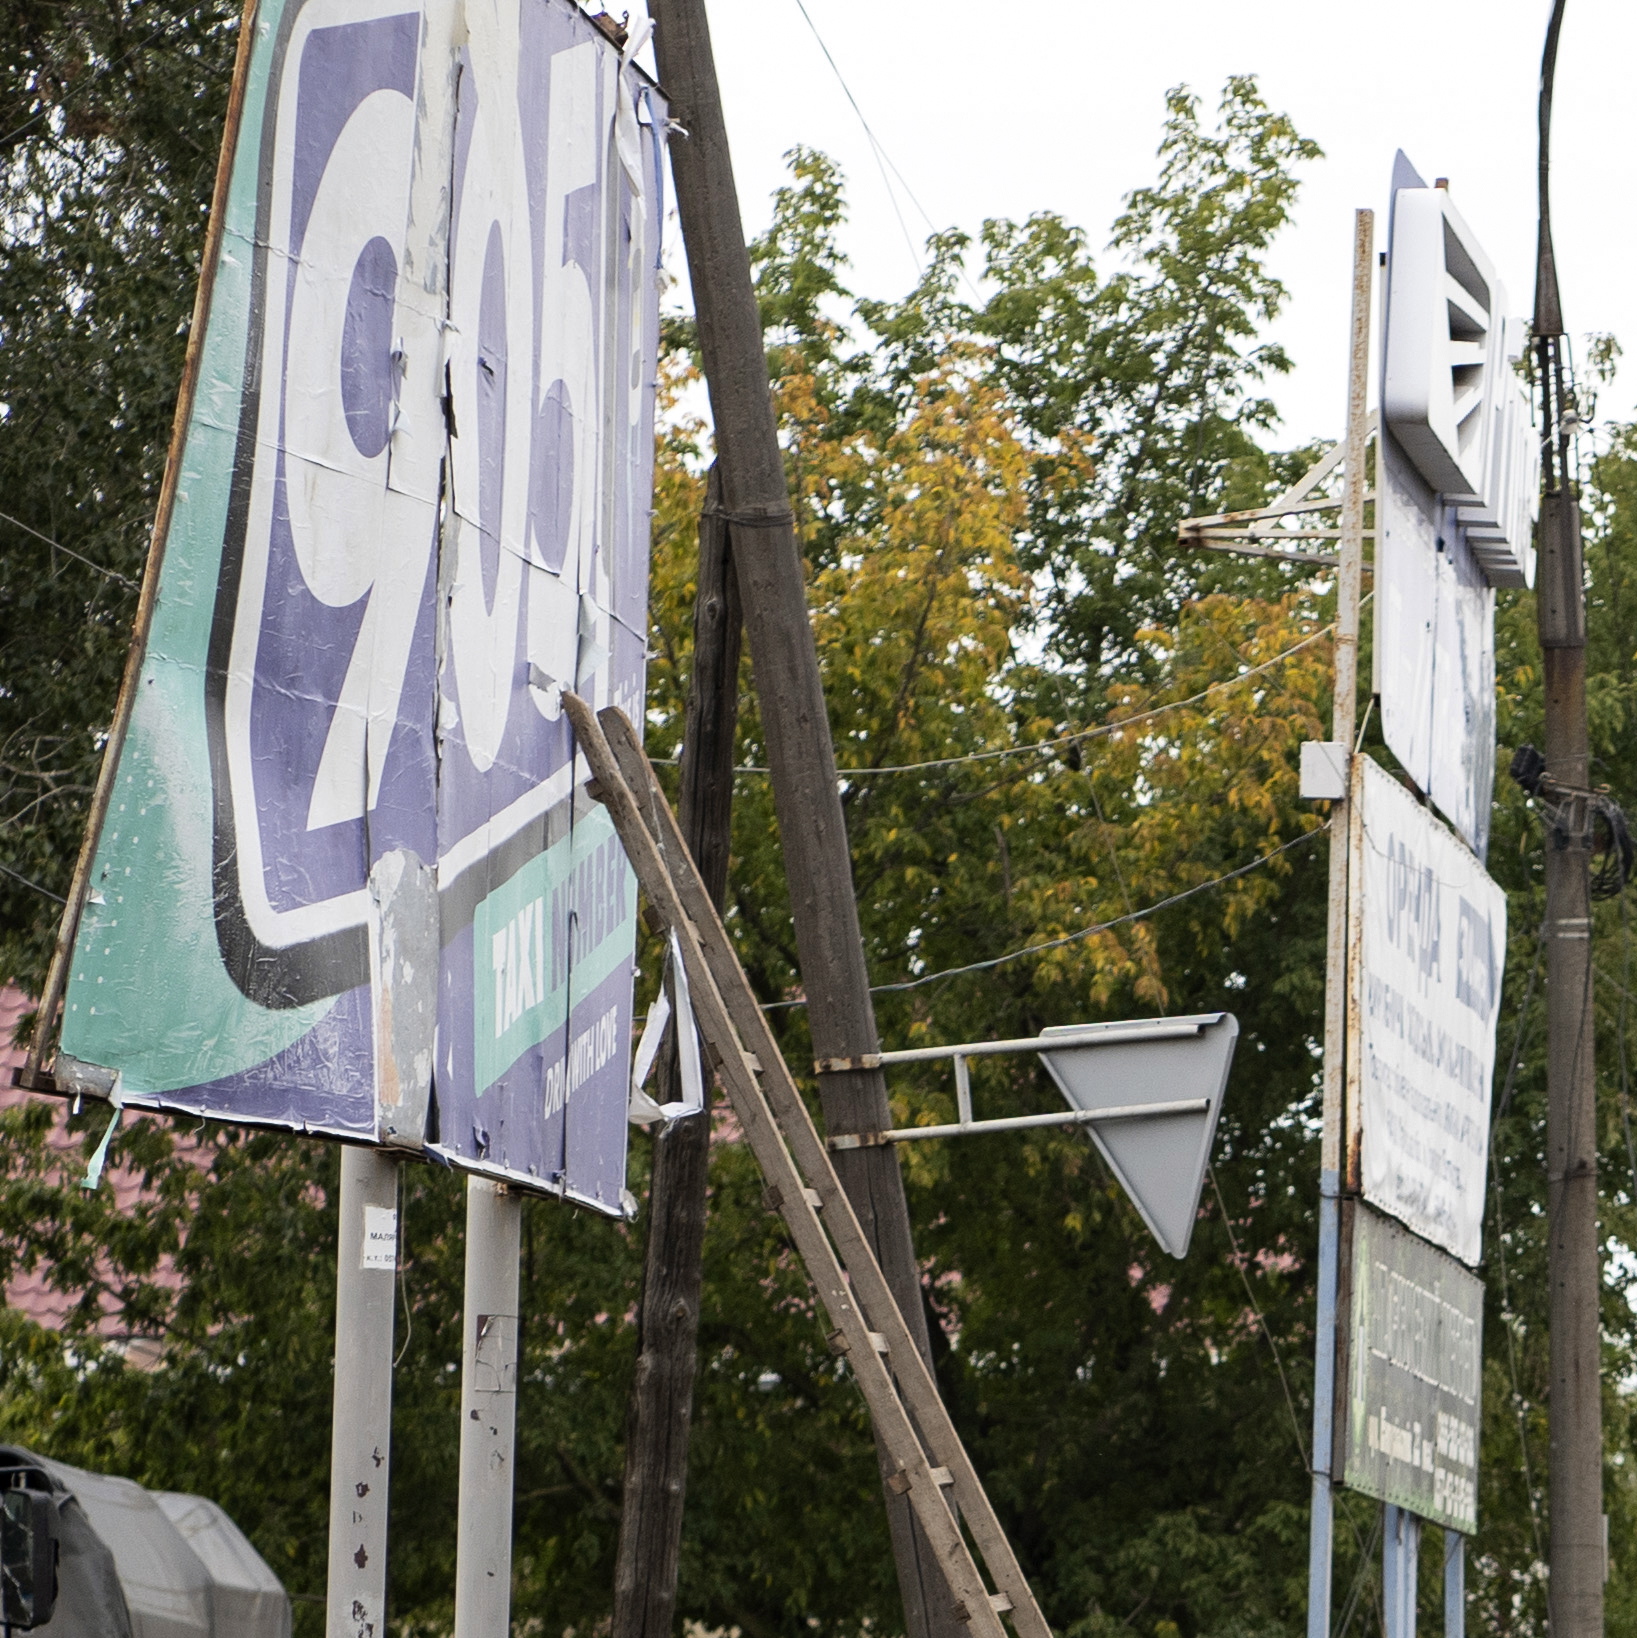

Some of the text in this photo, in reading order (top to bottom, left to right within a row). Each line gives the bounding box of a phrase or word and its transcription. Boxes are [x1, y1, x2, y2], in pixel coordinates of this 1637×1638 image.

[492, 833, 627, 1039] TAXI NUMBER
[570, 1024, 595, 1093] WITH
[595, 1004, 618, 1072] LOVE
